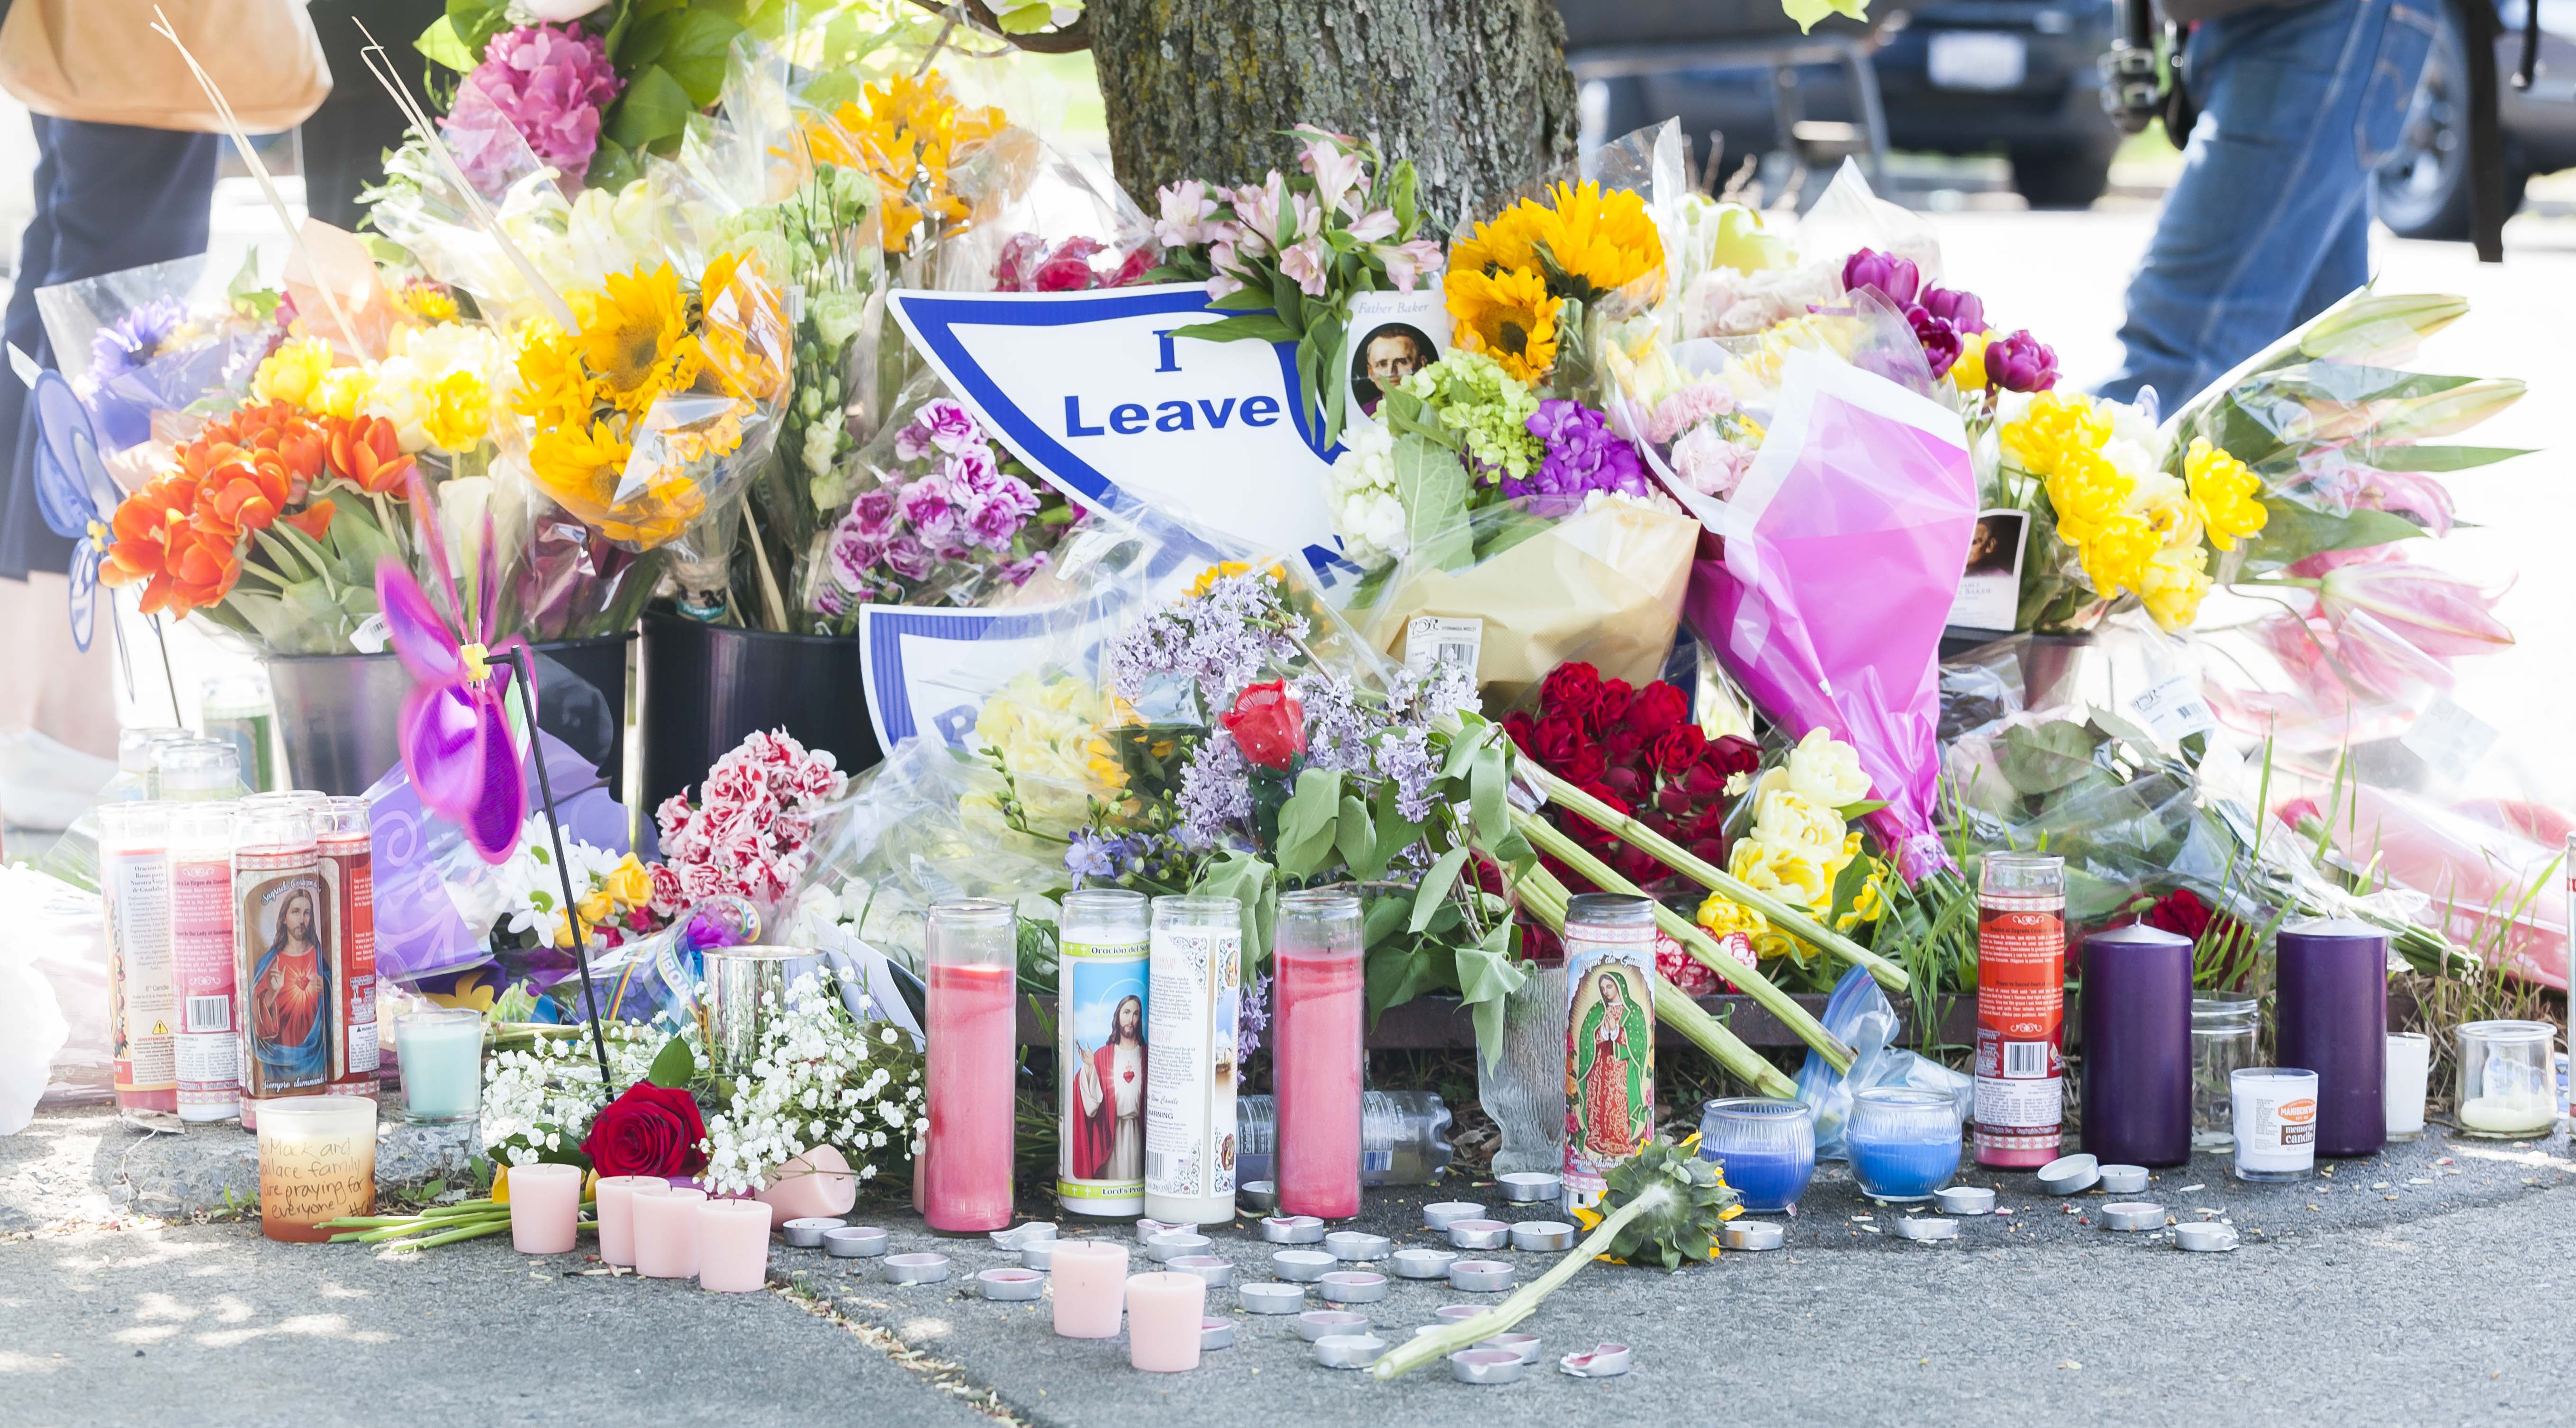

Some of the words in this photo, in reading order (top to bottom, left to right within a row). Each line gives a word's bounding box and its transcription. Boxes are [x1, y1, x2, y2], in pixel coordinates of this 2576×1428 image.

[1358, 301, 1393, 314] Father
[1397, 301, 1429, 314] Baker
[1152, 329, 1182, 373] I
[1065, 395, 1280, 438] Leave
[261, 879, 290, 906] Sagrado
[1091, 946, 1127, 955] Oración
[1128, 945, 1139, 953] del
[1577, 958, 1602, 974] Virgen
[1604, 950, 1617, 964] de
[260, 1079, 290, 1094] Siempre
[2285, 1123, 2313, 1134] memorial
[2285, 1131, 2314, 1144] candle
[320, 1137, 351, 1157] and
[307, 1156, 361, 1180] family
[264, 1184, 283, 1197] are
[285, 1180, 347, 1206] praying
[347, 1175, 364, 1193] for
[1103, 1187, 1128, 1195] Lord's
[1129, 1185, 1145, 1193] Pray
